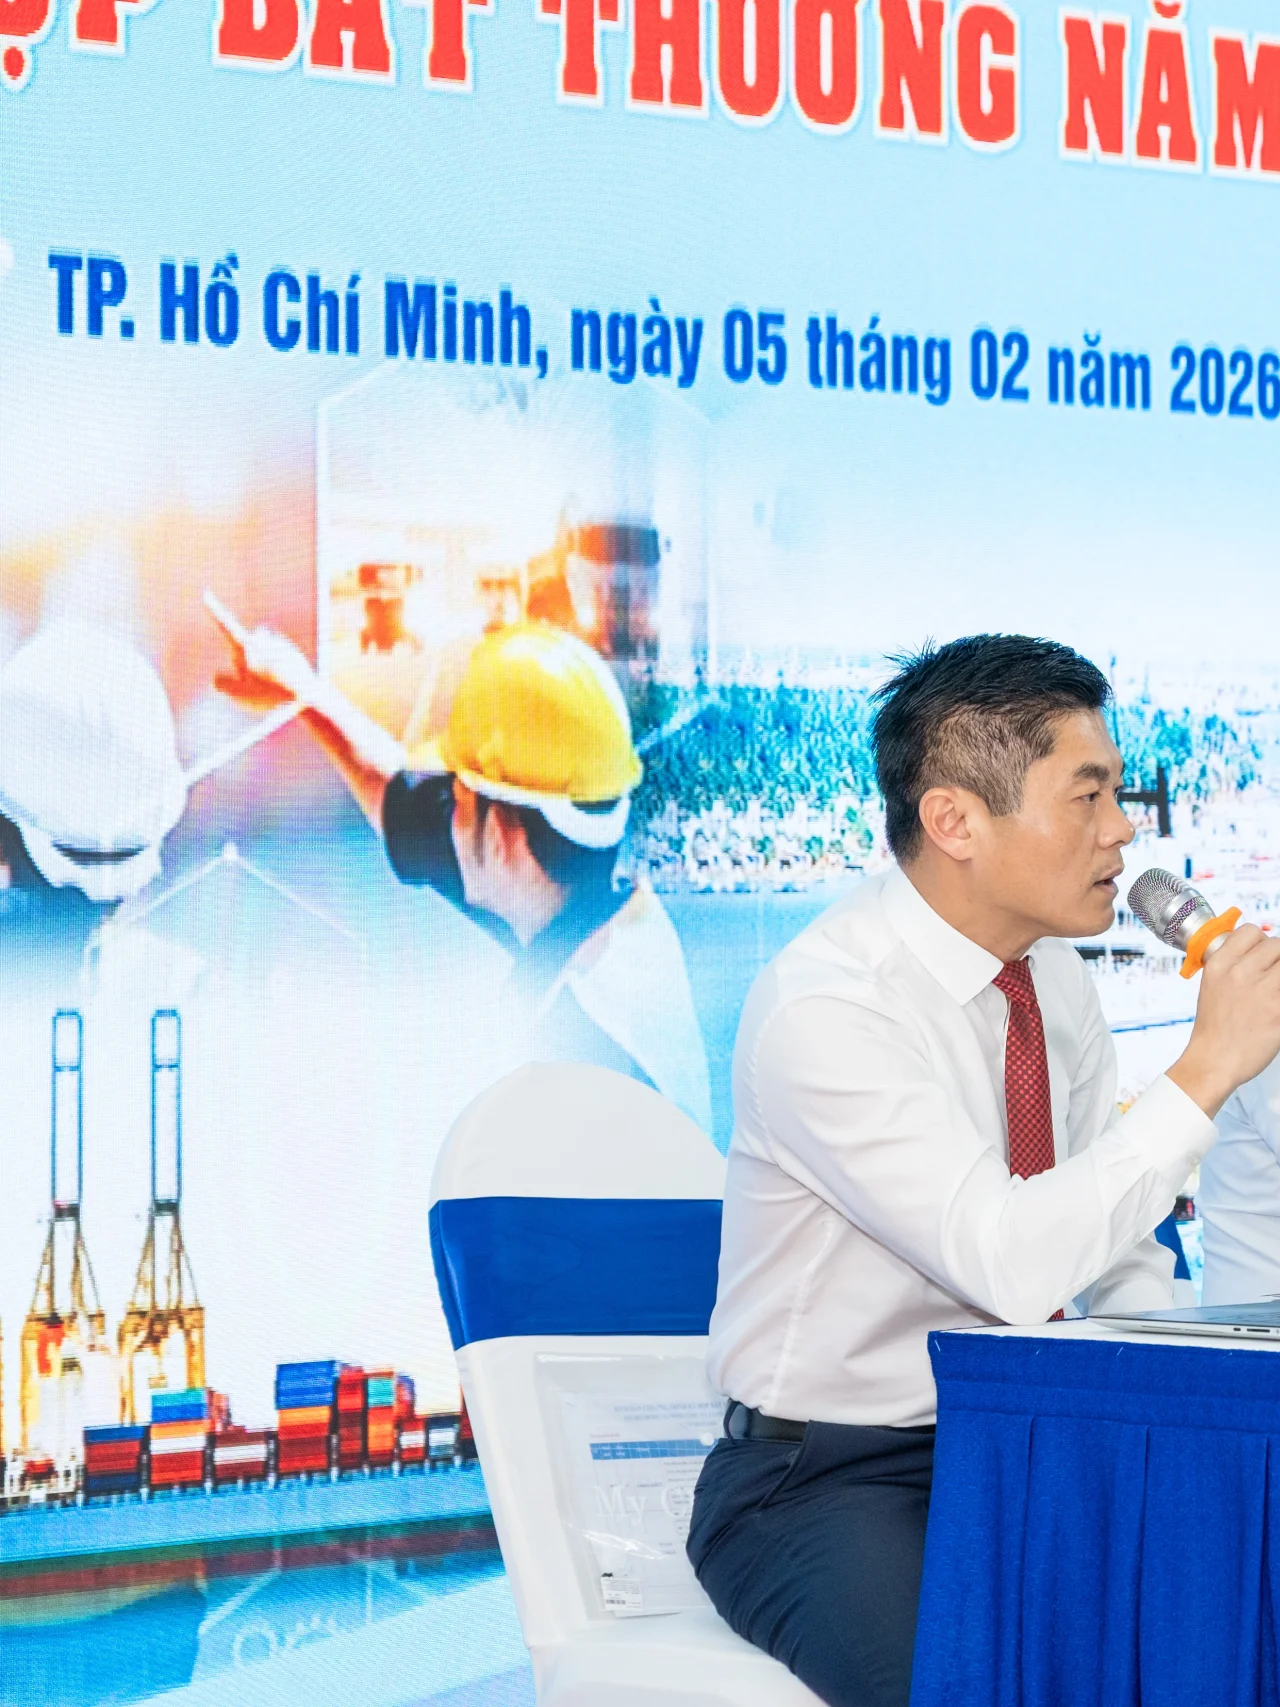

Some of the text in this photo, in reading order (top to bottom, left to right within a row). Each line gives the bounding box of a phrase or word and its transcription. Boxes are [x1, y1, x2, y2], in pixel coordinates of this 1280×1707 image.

[47, 249, 135, 339] TP.
[159, 251, 240, 348] Hồ
[262, 264, 362, 357] Chí
[384, 278, 549, 380] Minh,
[570, 295, 705, 389] ngày
[722, 306, 788, 386] 05
[805, 314, 952, 407] tháng
[969, 327, 1030, 403] 02
[1047, 331, 1152, 412] năm
